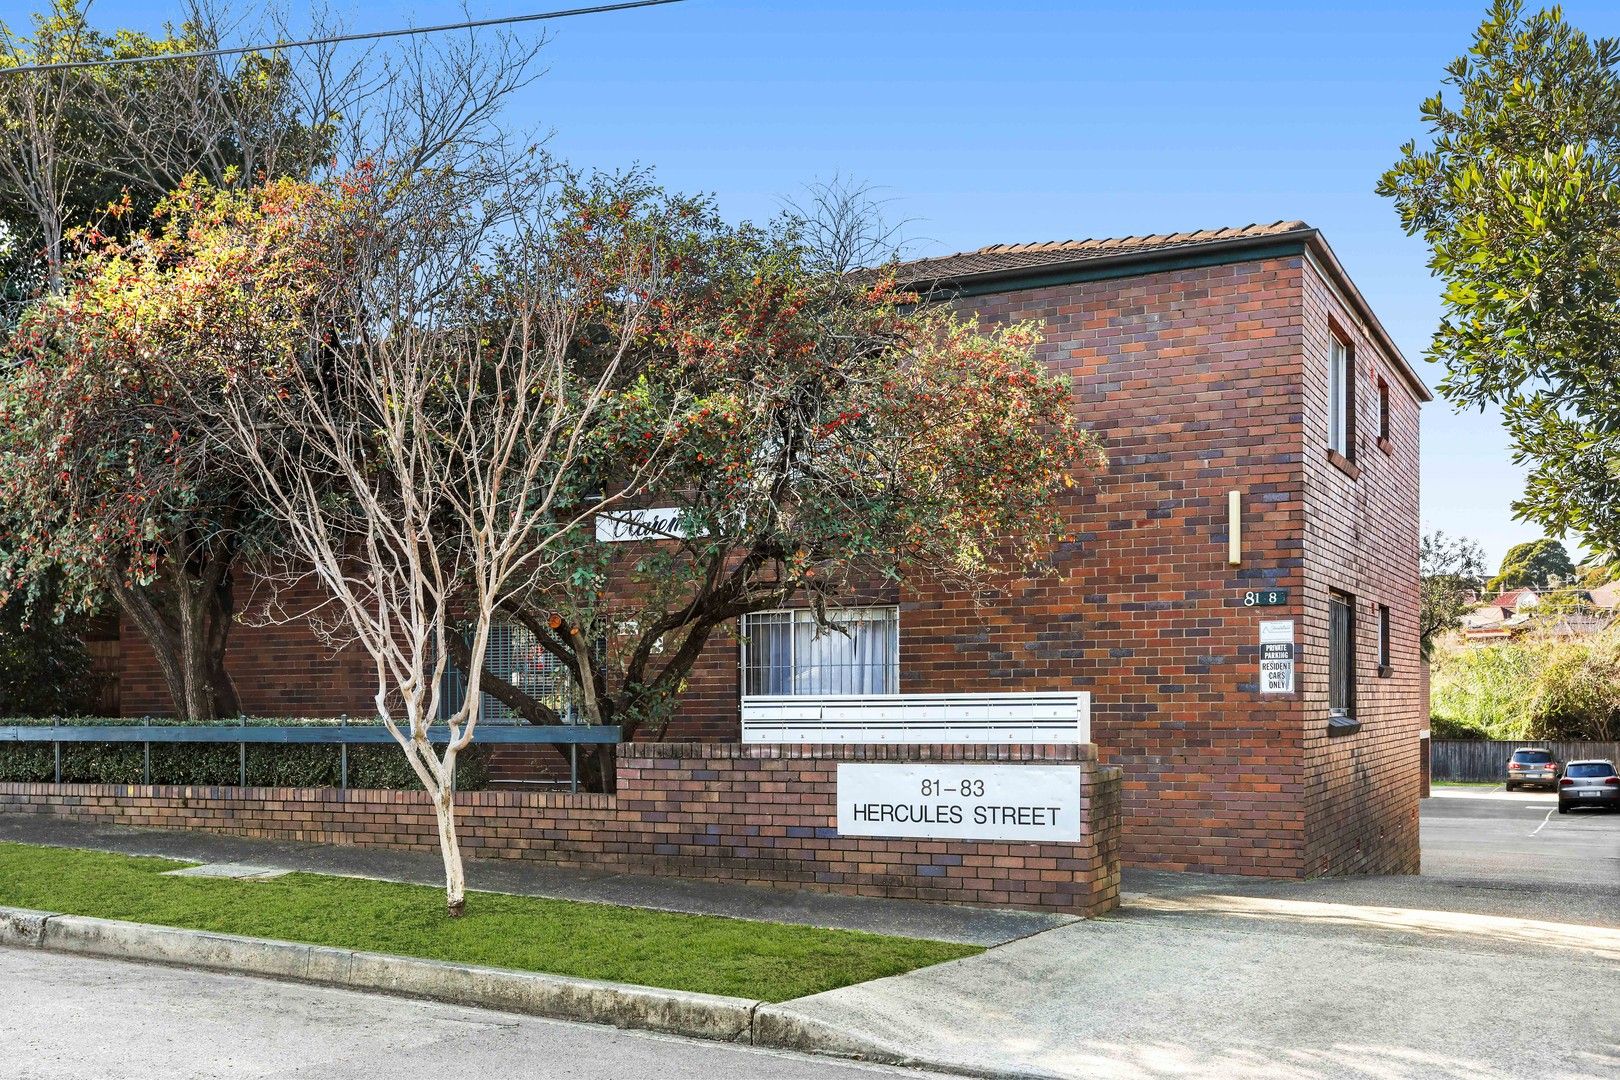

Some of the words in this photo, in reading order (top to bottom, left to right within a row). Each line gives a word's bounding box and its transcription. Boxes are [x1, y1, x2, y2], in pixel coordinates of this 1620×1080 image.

[1244, 591, 1259, 606] 81
[1269, 672, 1285, 680] CARS
[1269, 681, 1285, 689] ONLY
[921, 779, 985, 798] 81-83
[853, 803, 963, 824] HERCULES
[973, 805, 1061, 826] STREET
